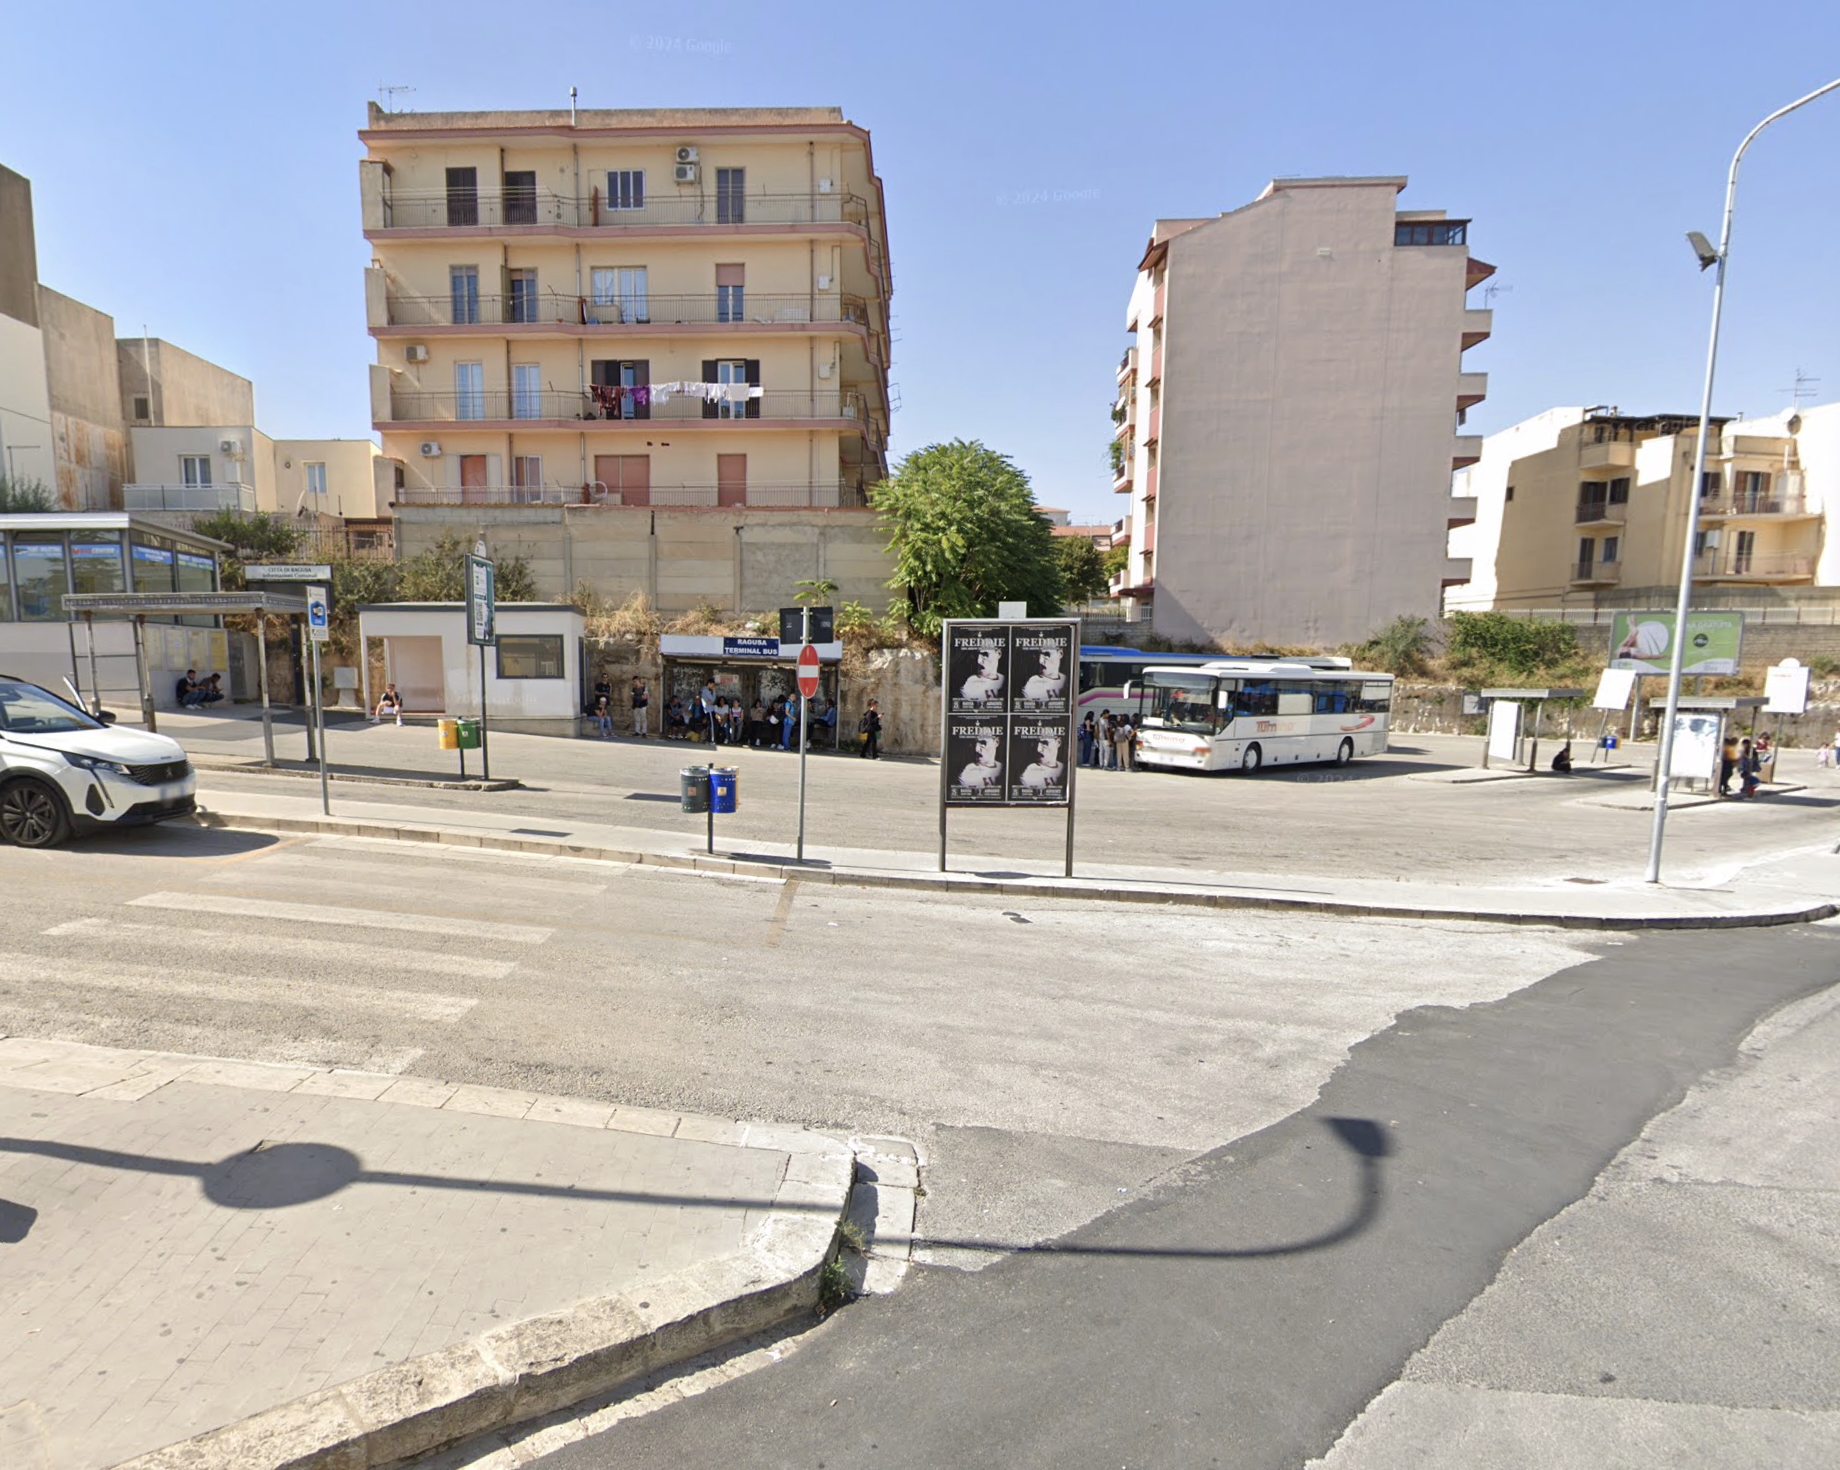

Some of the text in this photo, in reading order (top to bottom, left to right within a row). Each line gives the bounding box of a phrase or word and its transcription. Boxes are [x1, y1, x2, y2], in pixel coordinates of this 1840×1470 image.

[954, 638, 1006, 647] FREDDIE
[1016, 638, 1067, 647] FREDDIE
[725, 647, 761, 655] TERMINAL
[952, 727, 1003, 736] FREDDIE
[1014, 727, 1065, 736] FREDDIE
